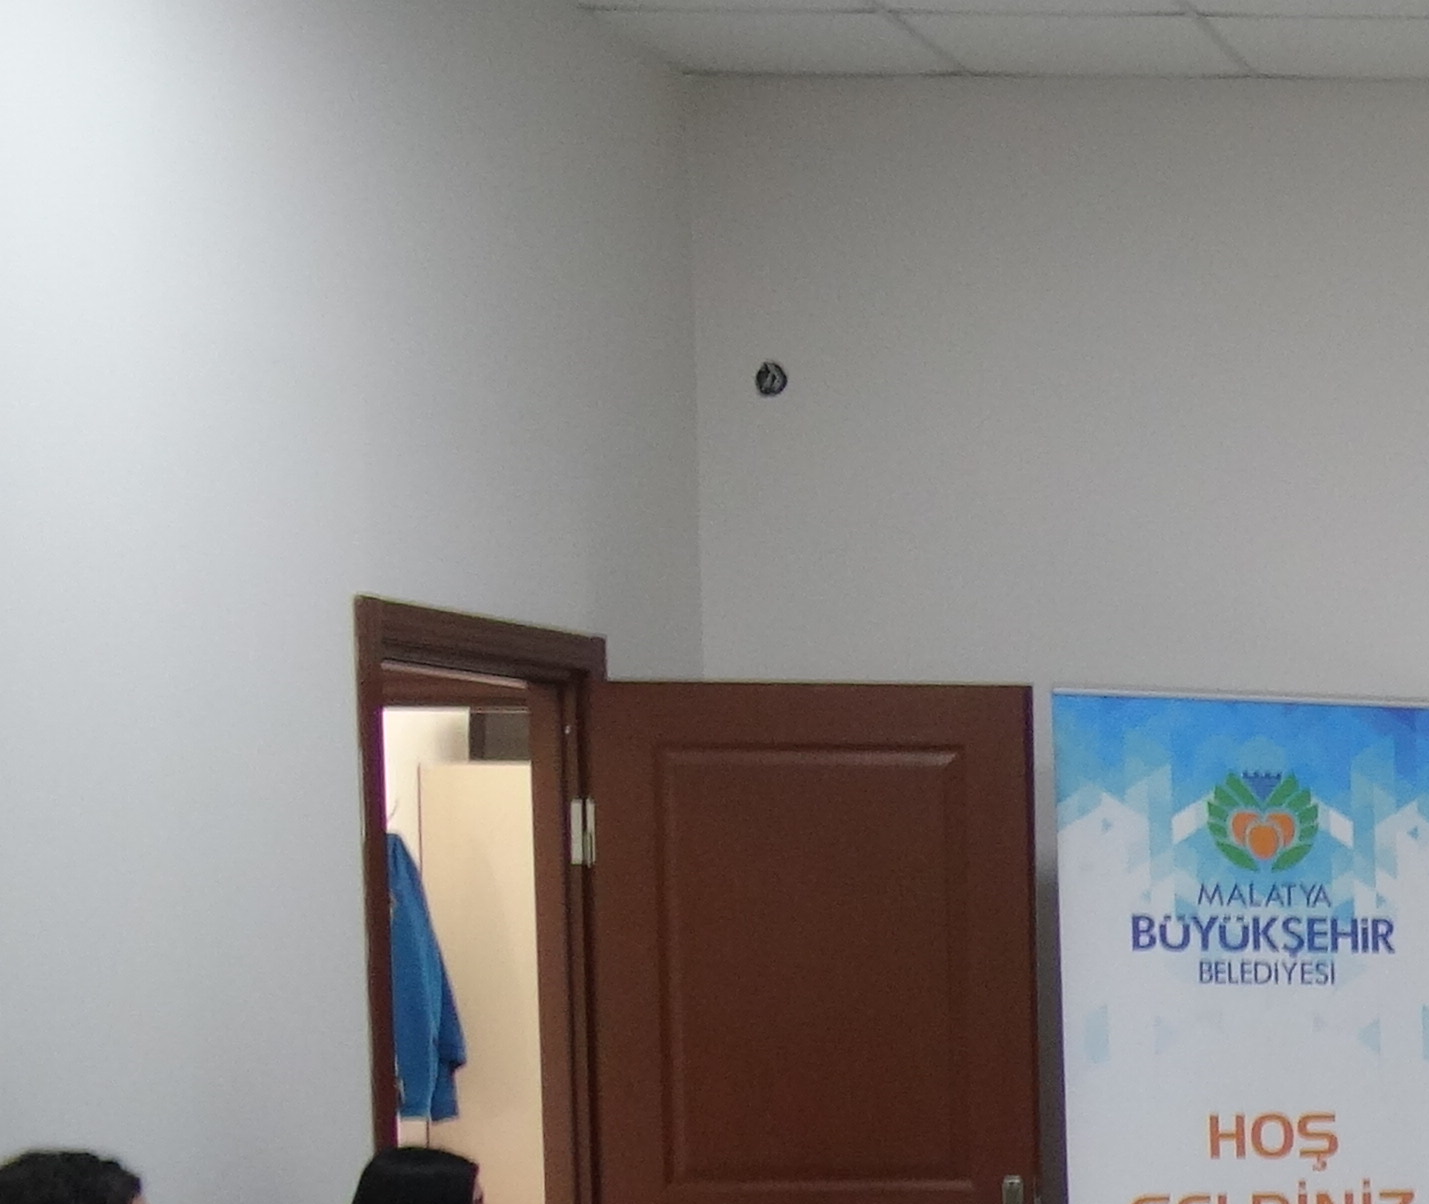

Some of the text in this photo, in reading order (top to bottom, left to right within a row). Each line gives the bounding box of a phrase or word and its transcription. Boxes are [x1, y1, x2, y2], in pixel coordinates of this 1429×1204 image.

[1198, 882, 1333, 908] MALATYA
[1131, 914, 1397, 957] BÜYÜKŞEHİR
[1209, 1111, 1340, 1171] HOŞ
